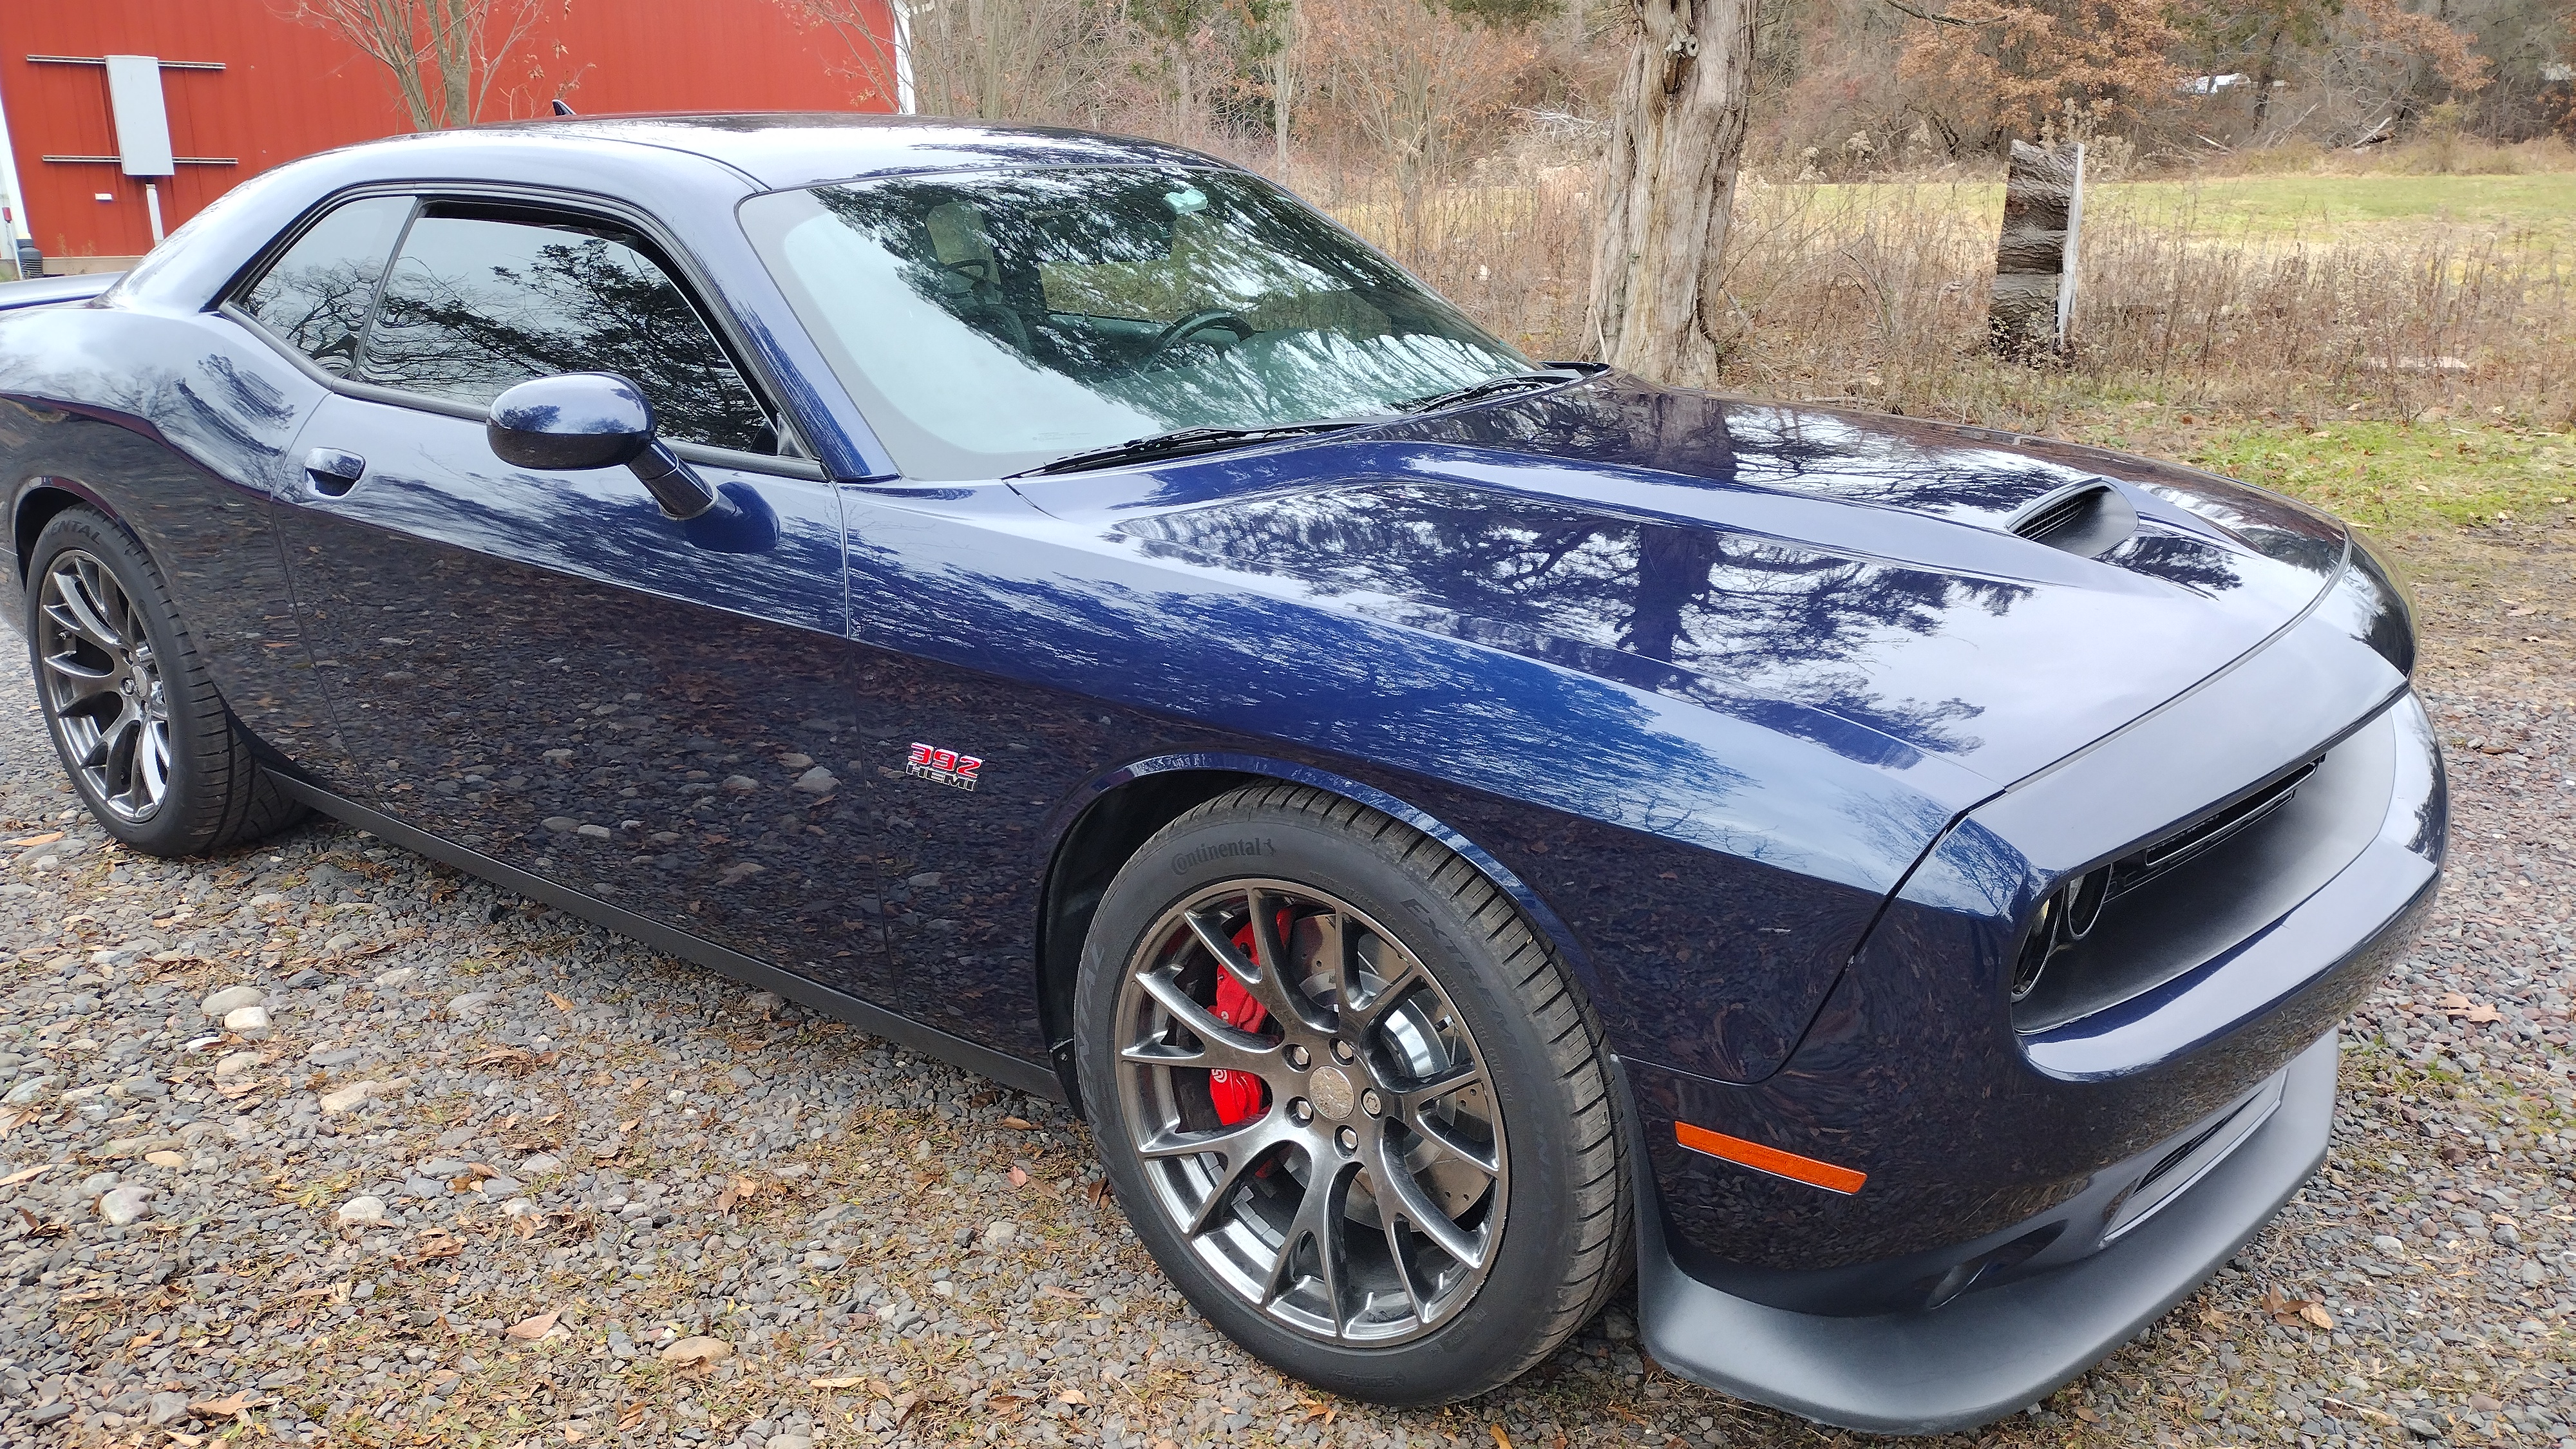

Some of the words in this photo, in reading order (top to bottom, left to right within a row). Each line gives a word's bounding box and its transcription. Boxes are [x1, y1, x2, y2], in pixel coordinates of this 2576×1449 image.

[906, 761, 977, 791] HEMI
[908, 742, 983, 779] 392
[1171, 838, 1261, 876] Continental
